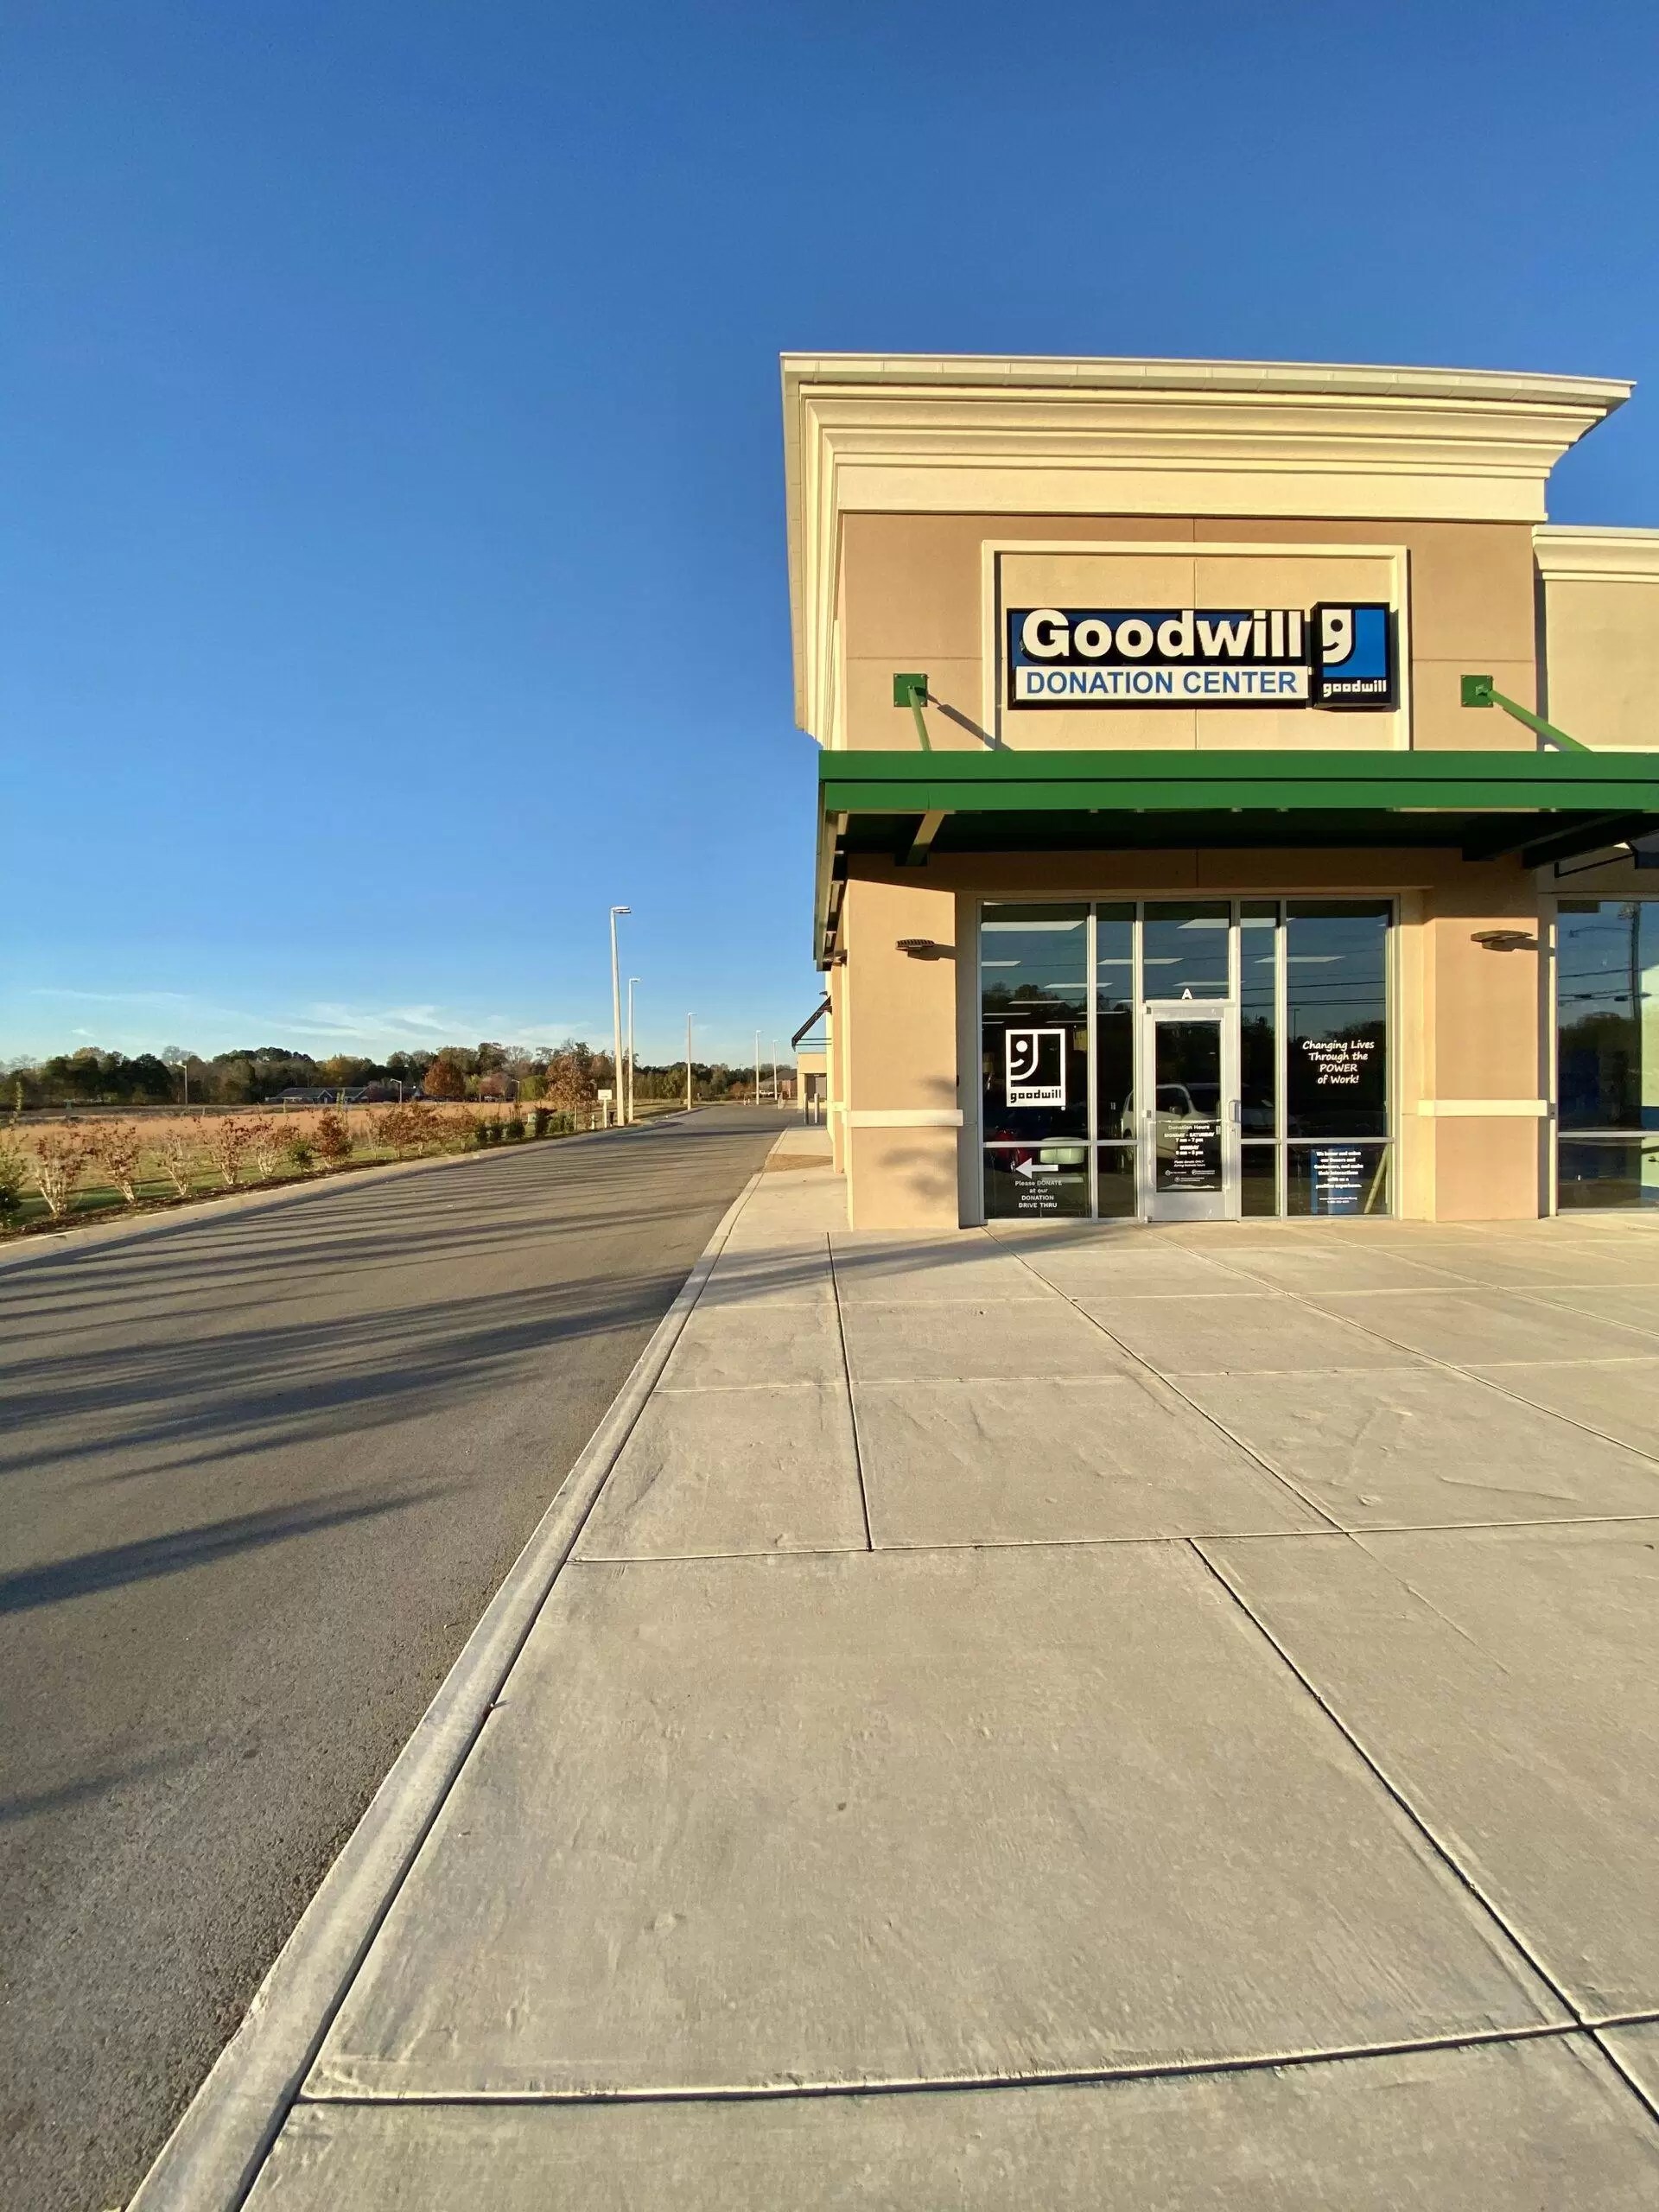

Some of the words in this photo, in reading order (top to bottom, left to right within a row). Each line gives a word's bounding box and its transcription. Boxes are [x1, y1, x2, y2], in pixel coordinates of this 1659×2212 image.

[1021, 608, 1303, 658] Goodwill
[1027, 671, 1173, 694] DONATION
[1182, 671, 1297, 694] CENTER
[1322, 679, 1387, 698] goodwill
[1181, 988, 1192, 1000] A
[1302, 1039, 1348, 1052] Changing
[1351, 1039, 1376, 1049] Lives
[1308, 1052, 1350, 1064] Through
[1352, 1052, 1369, 1060] the
[1319, 1064, 1357, 1072] POWER
[1317, 1074, 1329, 1084] of
[1331, 1074, 1360, 1084] Work!
[1010, 1089, 1062, 1104] goodwill
